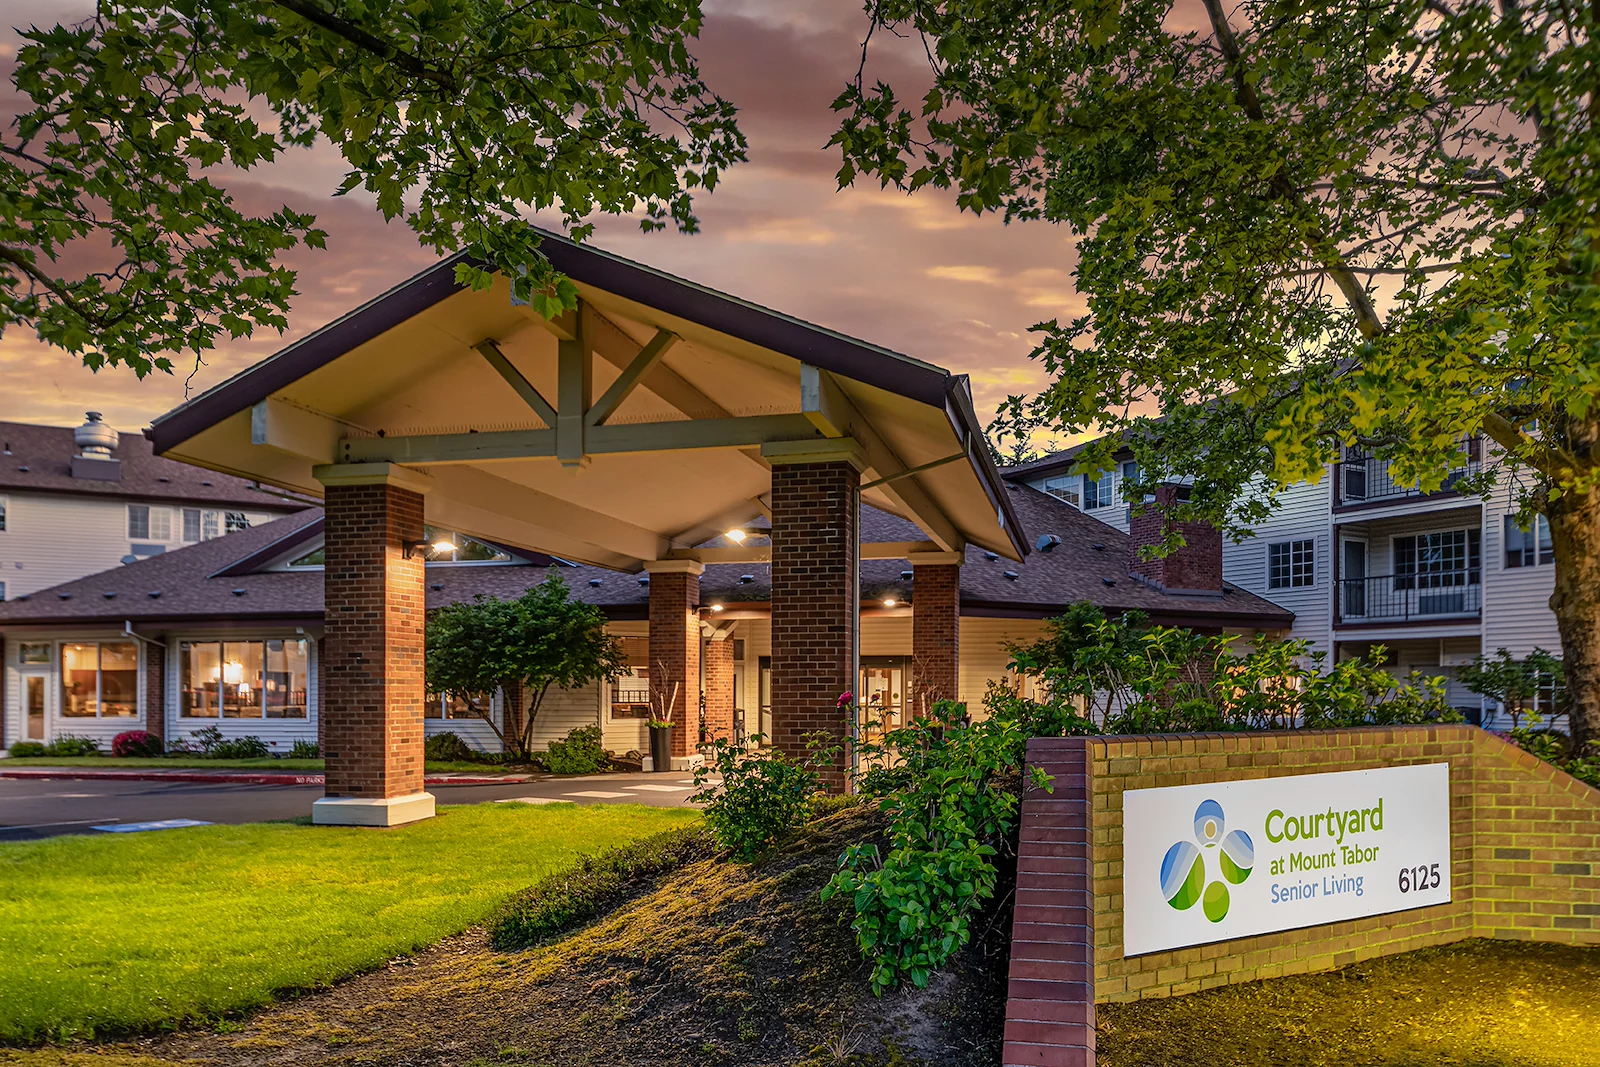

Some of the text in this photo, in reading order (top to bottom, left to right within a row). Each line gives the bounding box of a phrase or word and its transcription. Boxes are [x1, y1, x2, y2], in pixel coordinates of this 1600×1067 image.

[1265, 798, 1383, 845] Courtyard
[1270, 844, 1380, 876] at Mount Tabor
[1271, 873, 1364, 904] Senior Living
[1398, 863, 1441, 893] 6125
